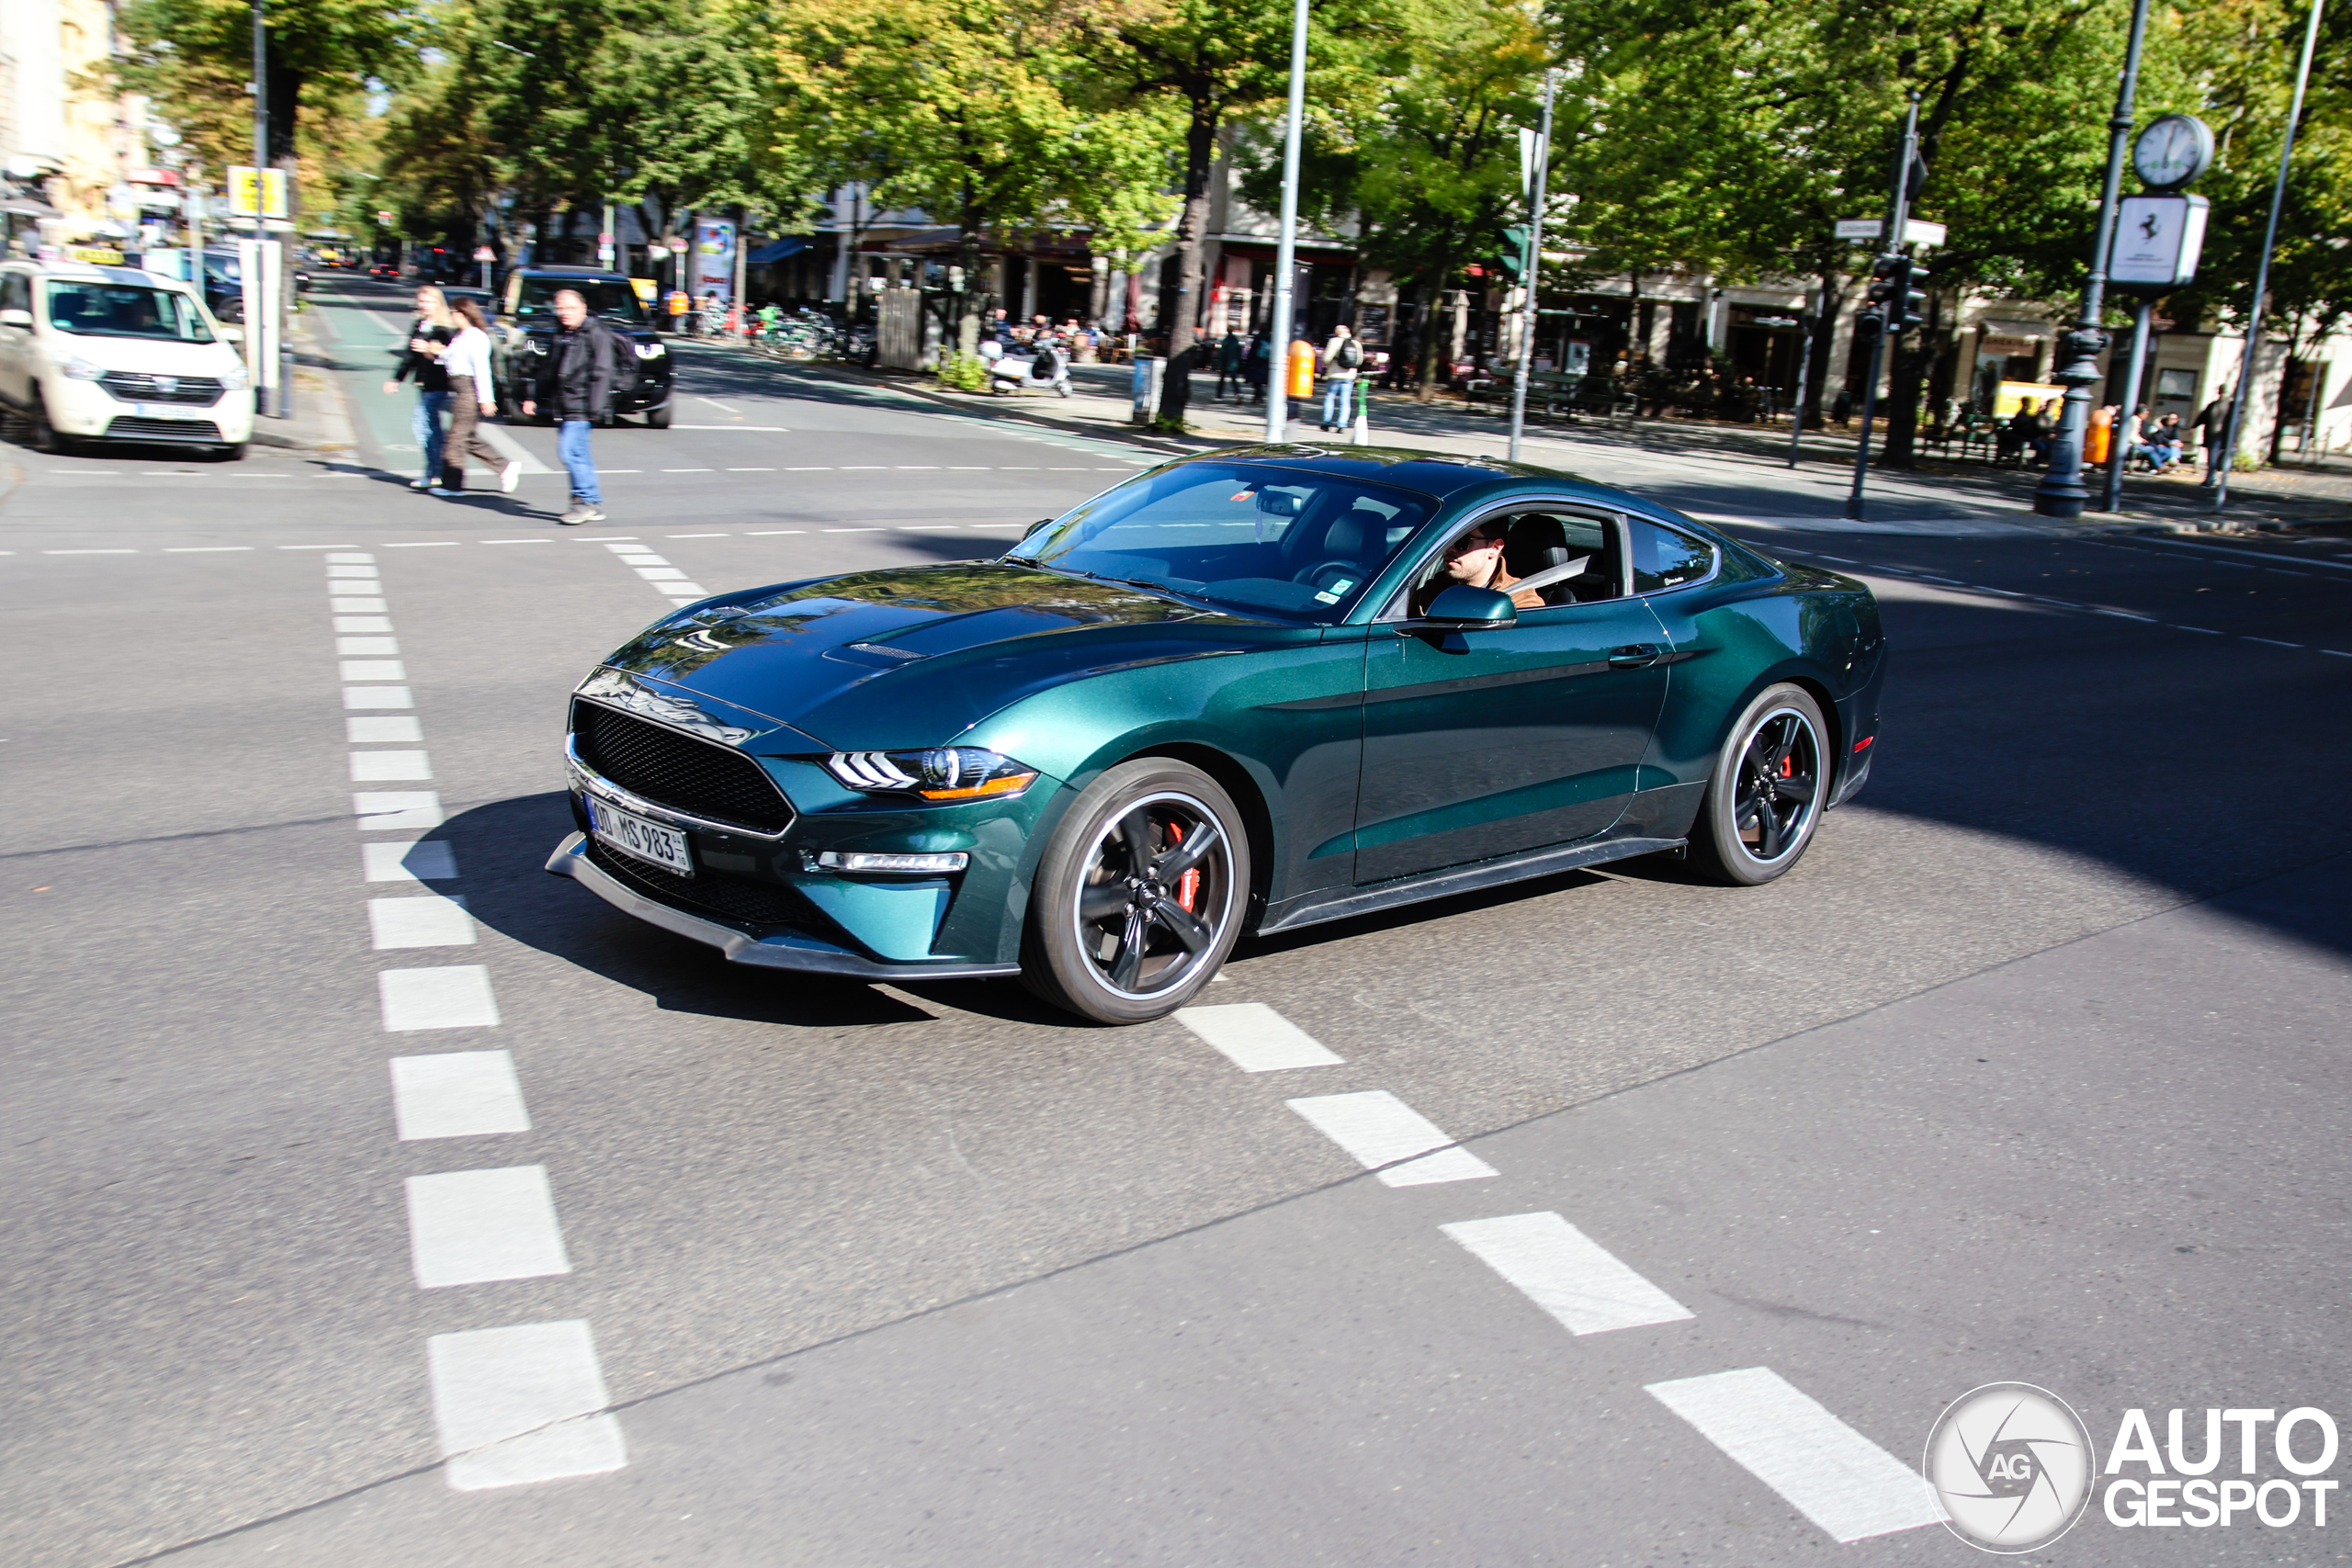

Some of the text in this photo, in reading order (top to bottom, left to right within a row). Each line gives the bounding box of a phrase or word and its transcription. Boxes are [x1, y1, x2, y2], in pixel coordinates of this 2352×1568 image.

[594, 802, 613, 836] OD
[617, 815, 641, 850] MS
[641, 825, 674, 862] 983
